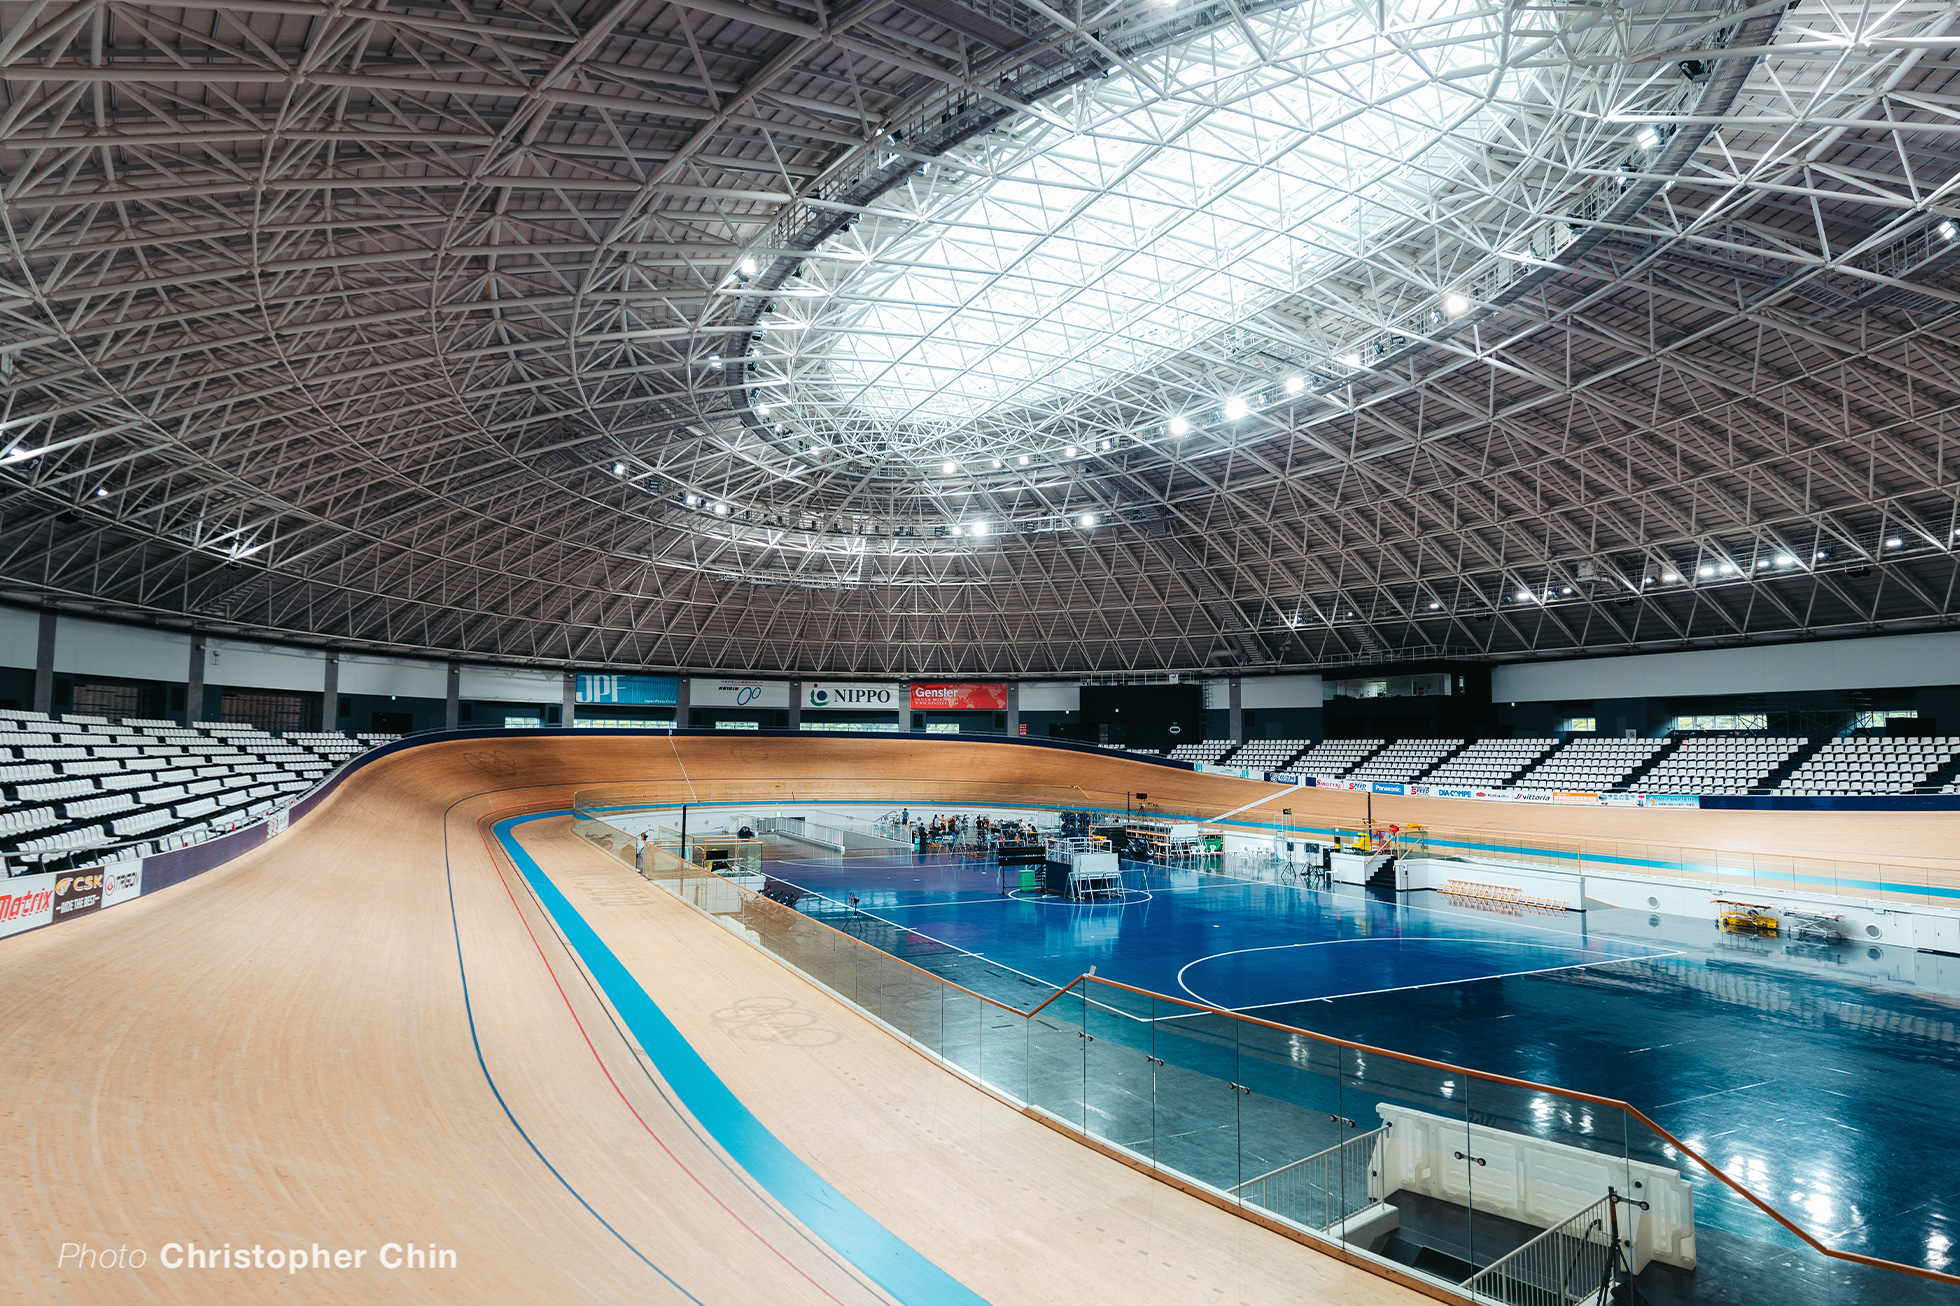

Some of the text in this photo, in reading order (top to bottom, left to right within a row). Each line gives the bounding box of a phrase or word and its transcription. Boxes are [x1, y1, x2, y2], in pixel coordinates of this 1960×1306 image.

[576, 675, 626, 703] JPF
[834, 689, 891, 704] NIPPO
[915, 687, 958, 698] Gensler
[1375, 784, 1401, 793] Panasonic
[73, 875, 103, 892] CSK
[0, 888, 53, 922] Matrix
[61, 894, 96, 914] RIDE THE BEST
